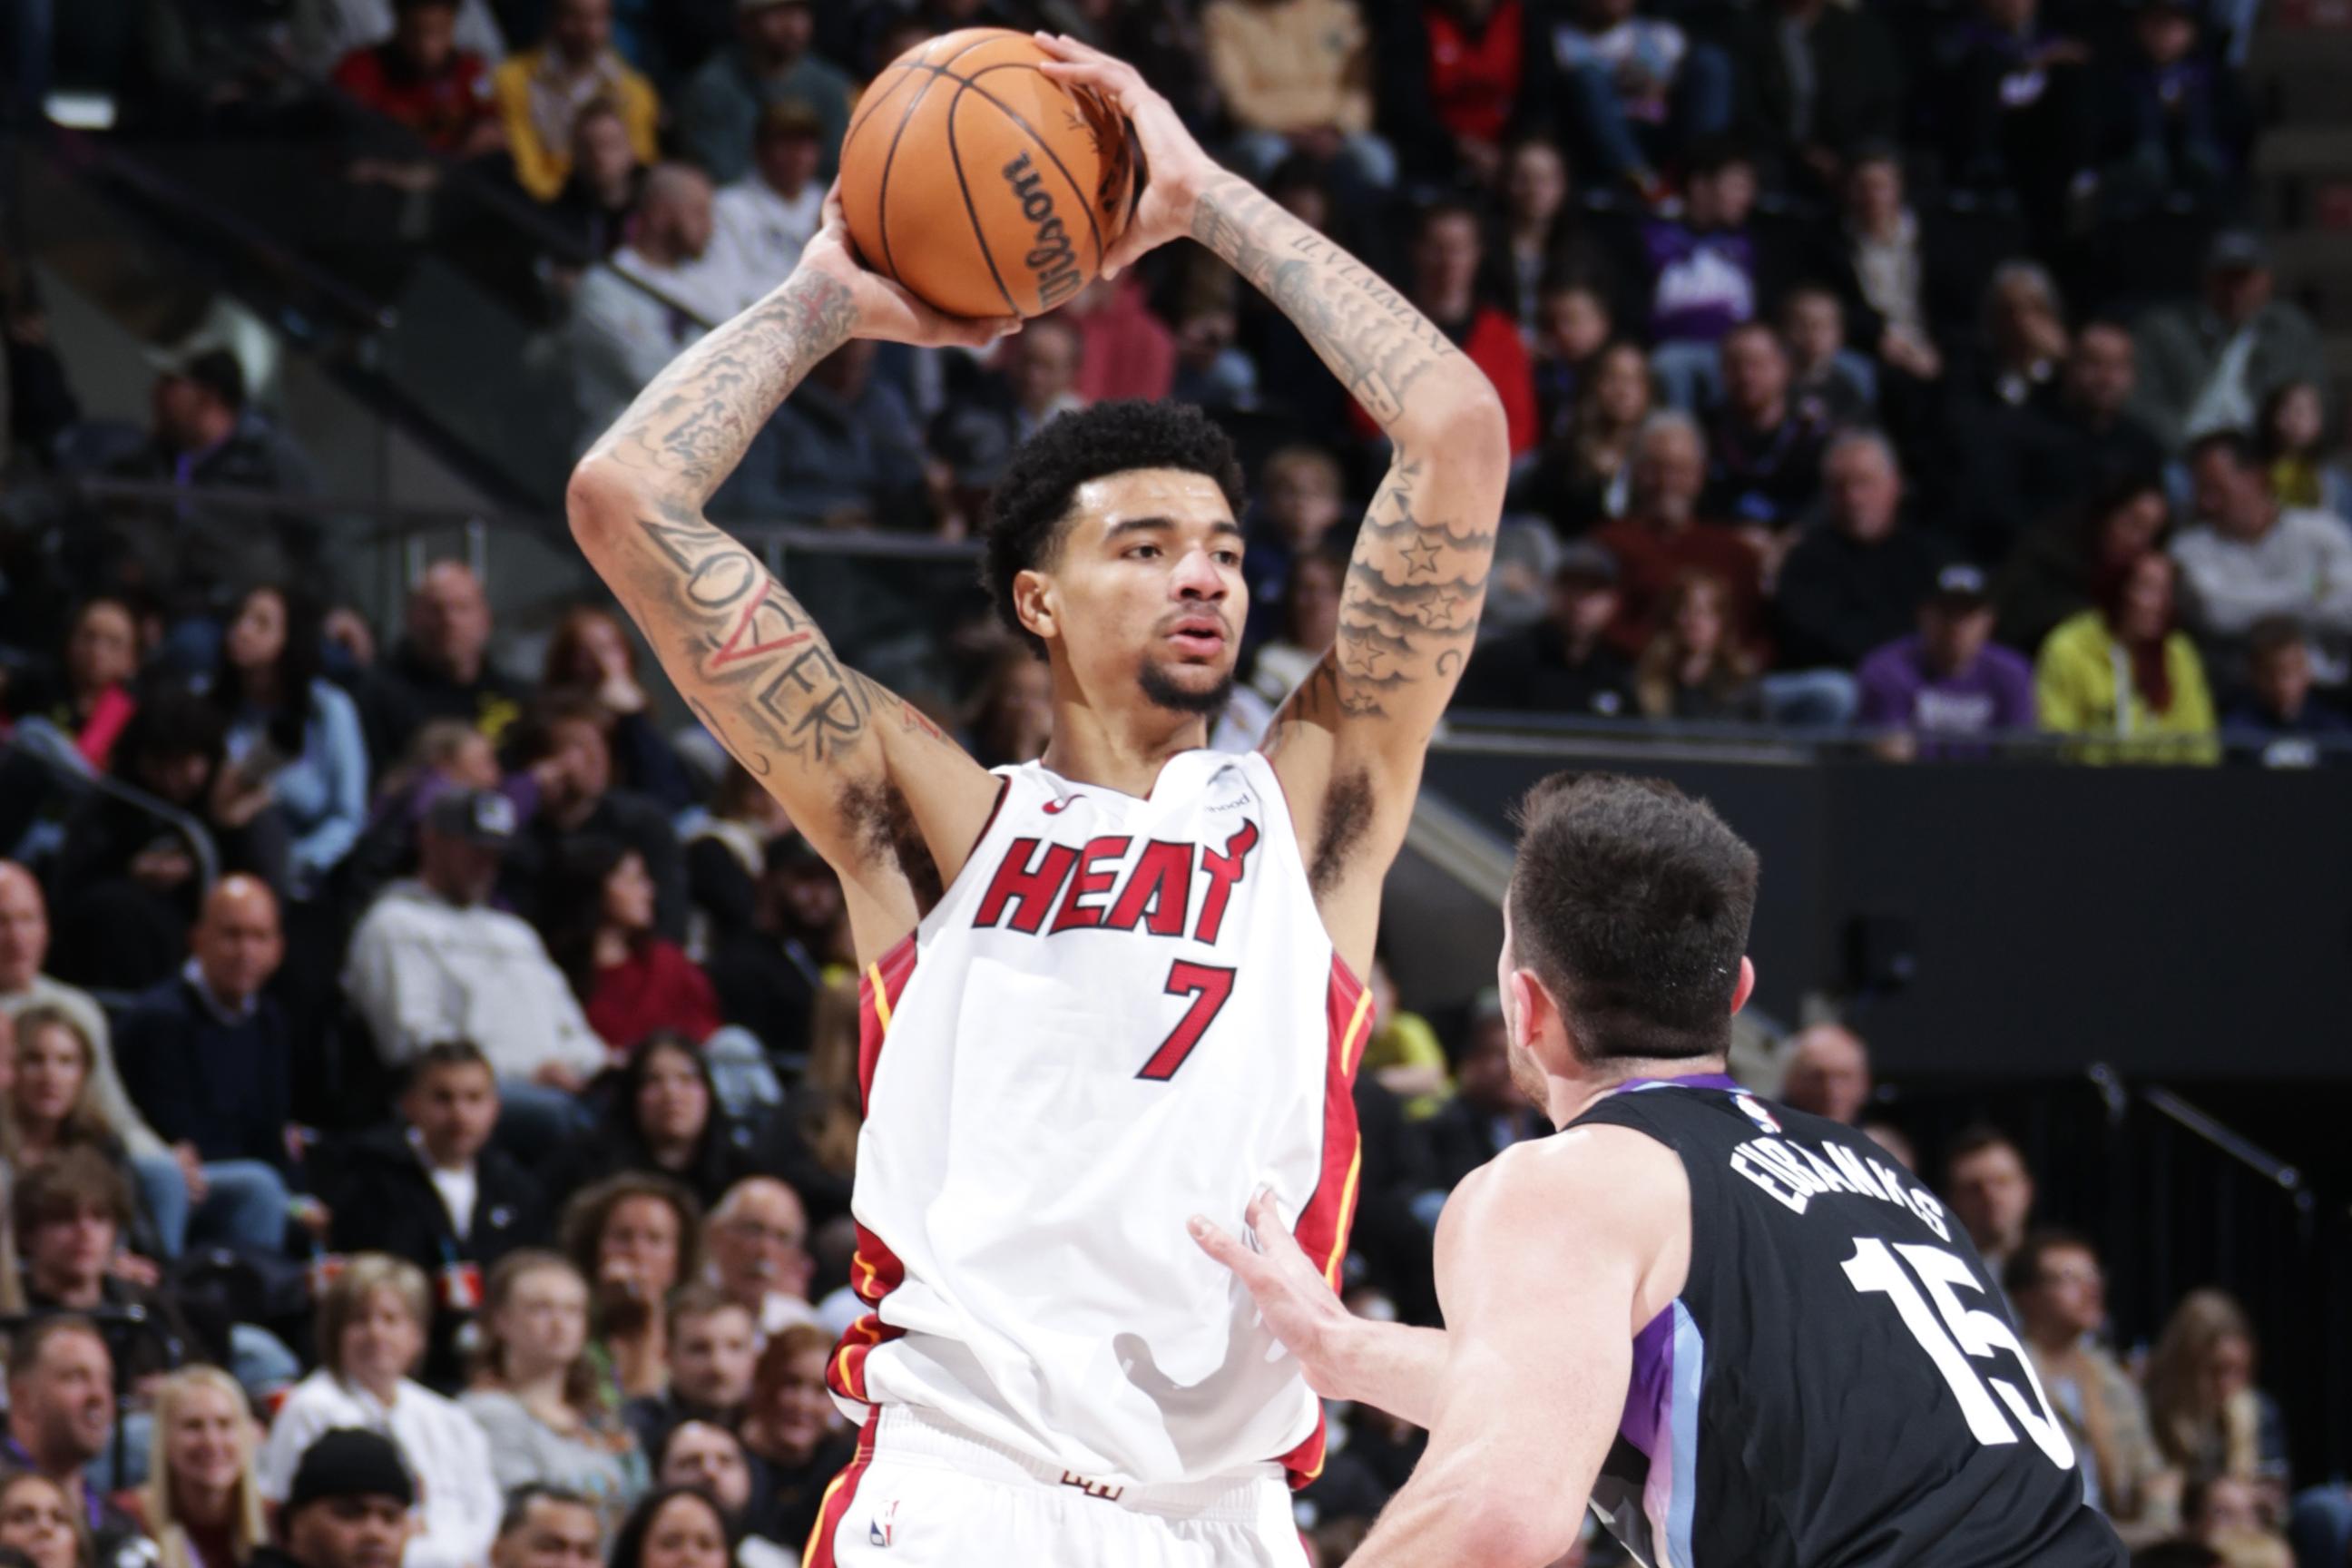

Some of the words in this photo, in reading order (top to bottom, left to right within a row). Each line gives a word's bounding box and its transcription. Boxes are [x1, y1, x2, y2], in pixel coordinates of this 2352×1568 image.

[1001, 150, 1083, 310] Wilson
[971, 817, 1259, 946] HEAT
[1133, 957, 1239, 1082] 7
[1730, 1135, 1952, 1243] EUBANKS
[1839, 1236, 2076, 1470] 15
